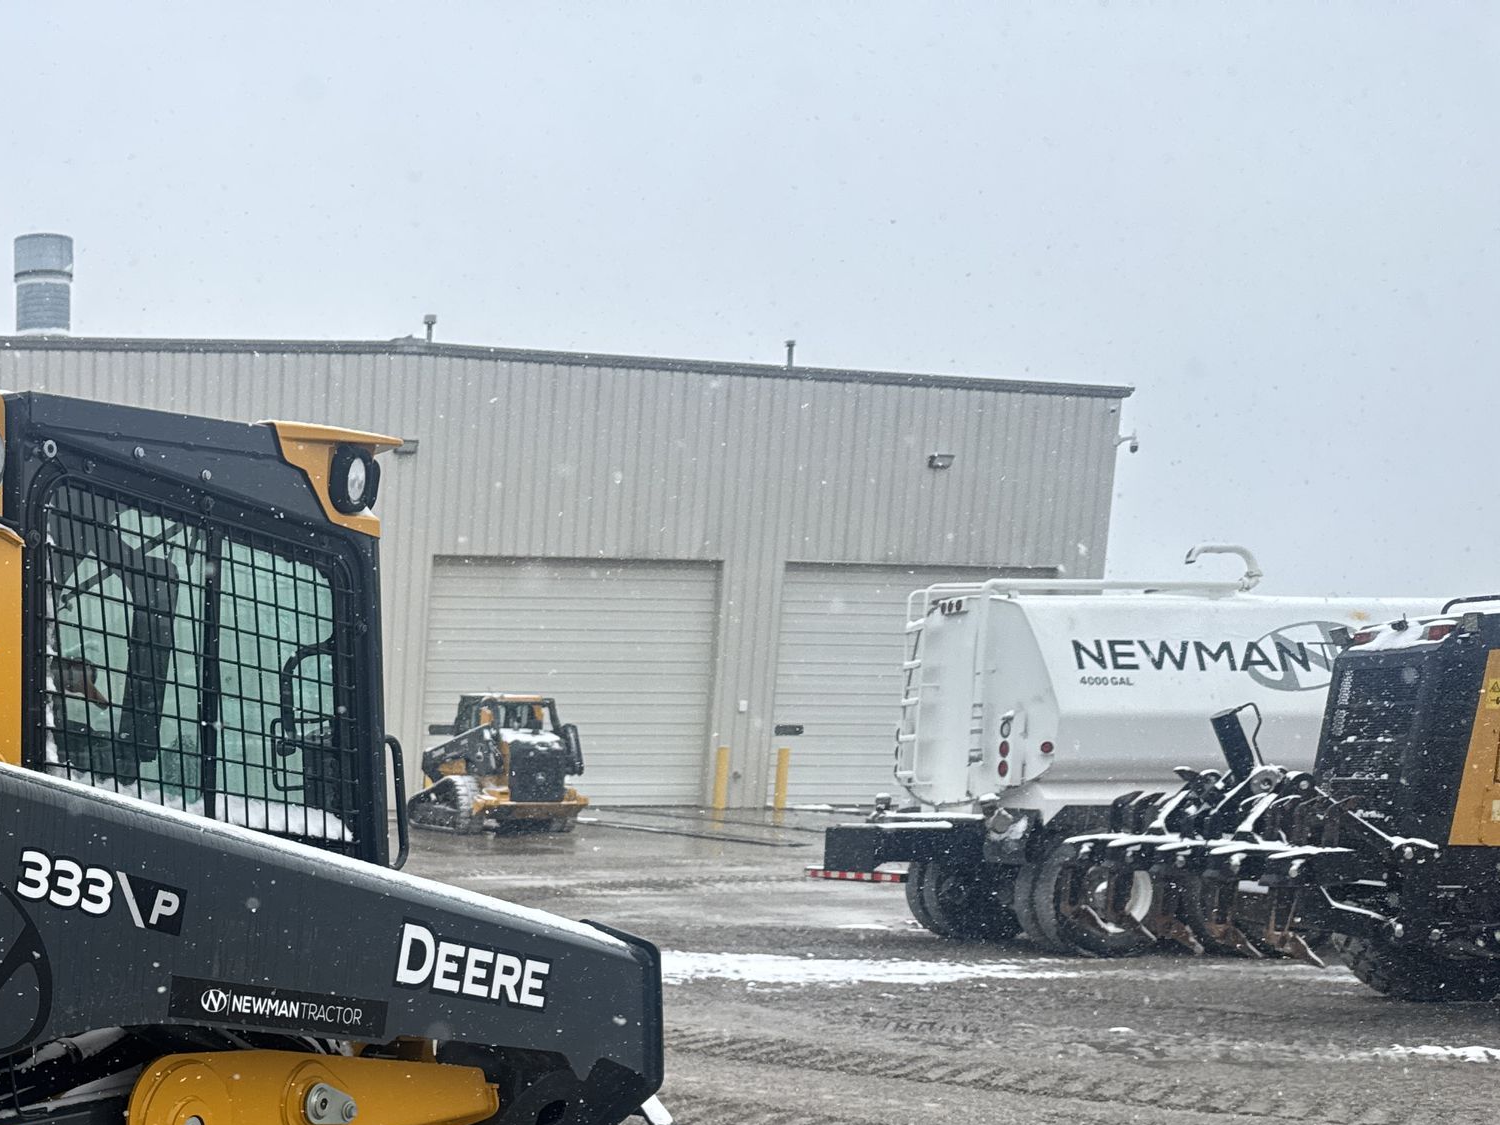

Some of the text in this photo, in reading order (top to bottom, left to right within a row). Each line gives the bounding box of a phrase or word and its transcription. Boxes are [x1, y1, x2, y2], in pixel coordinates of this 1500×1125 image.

[1080, 676, 1134, 686] 4000 GAL
[16, 850, 114, 915] 333
[396, 922, 551, 1018] DEERE
